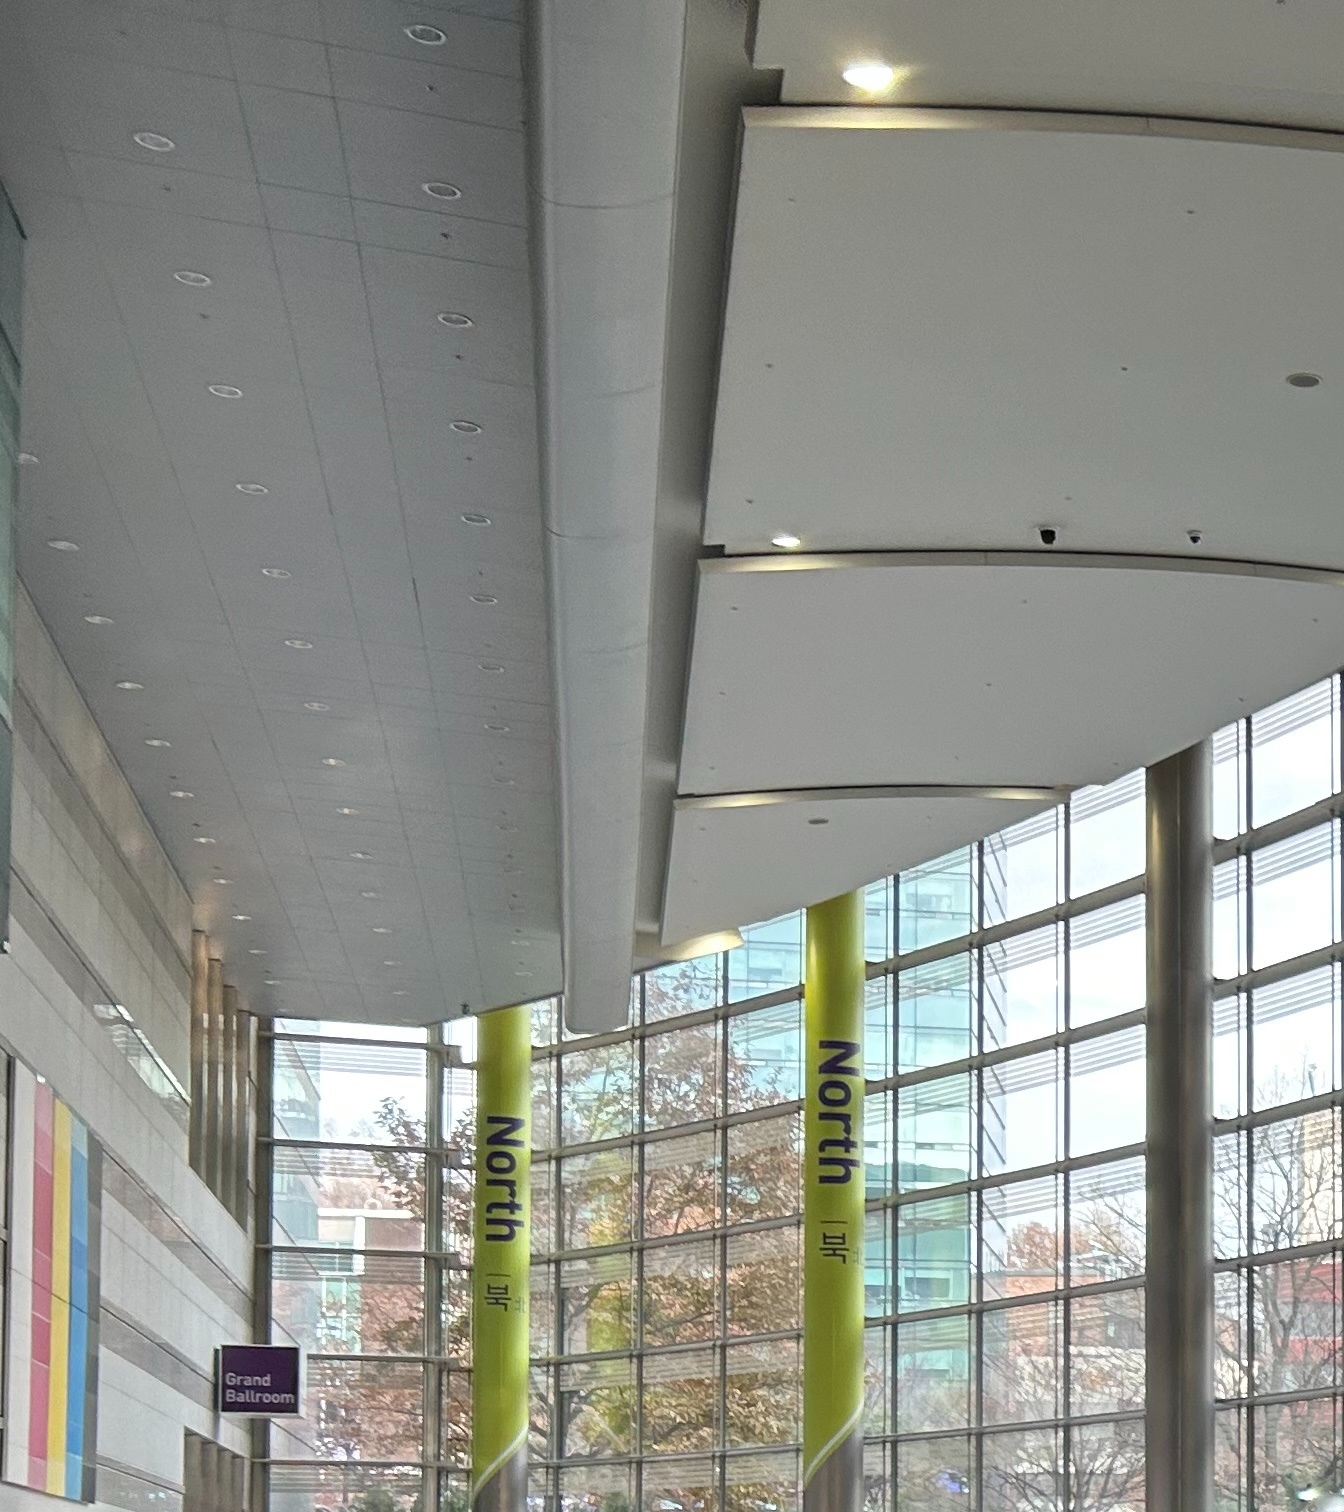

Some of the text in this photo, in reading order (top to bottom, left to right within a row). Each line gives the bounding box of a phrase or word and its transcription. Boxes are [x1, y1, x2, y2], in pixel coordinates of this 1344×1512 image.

[818, 1040, 860, 1184] North
[485, 1116, 525, 1242] North
[819, 1232, 849, 1264] 북
[484, 1284, 511, 1312] 북
[225, 1372, 271, 1387] Grand
[225, 1389, 295, 1403] Ballroom
